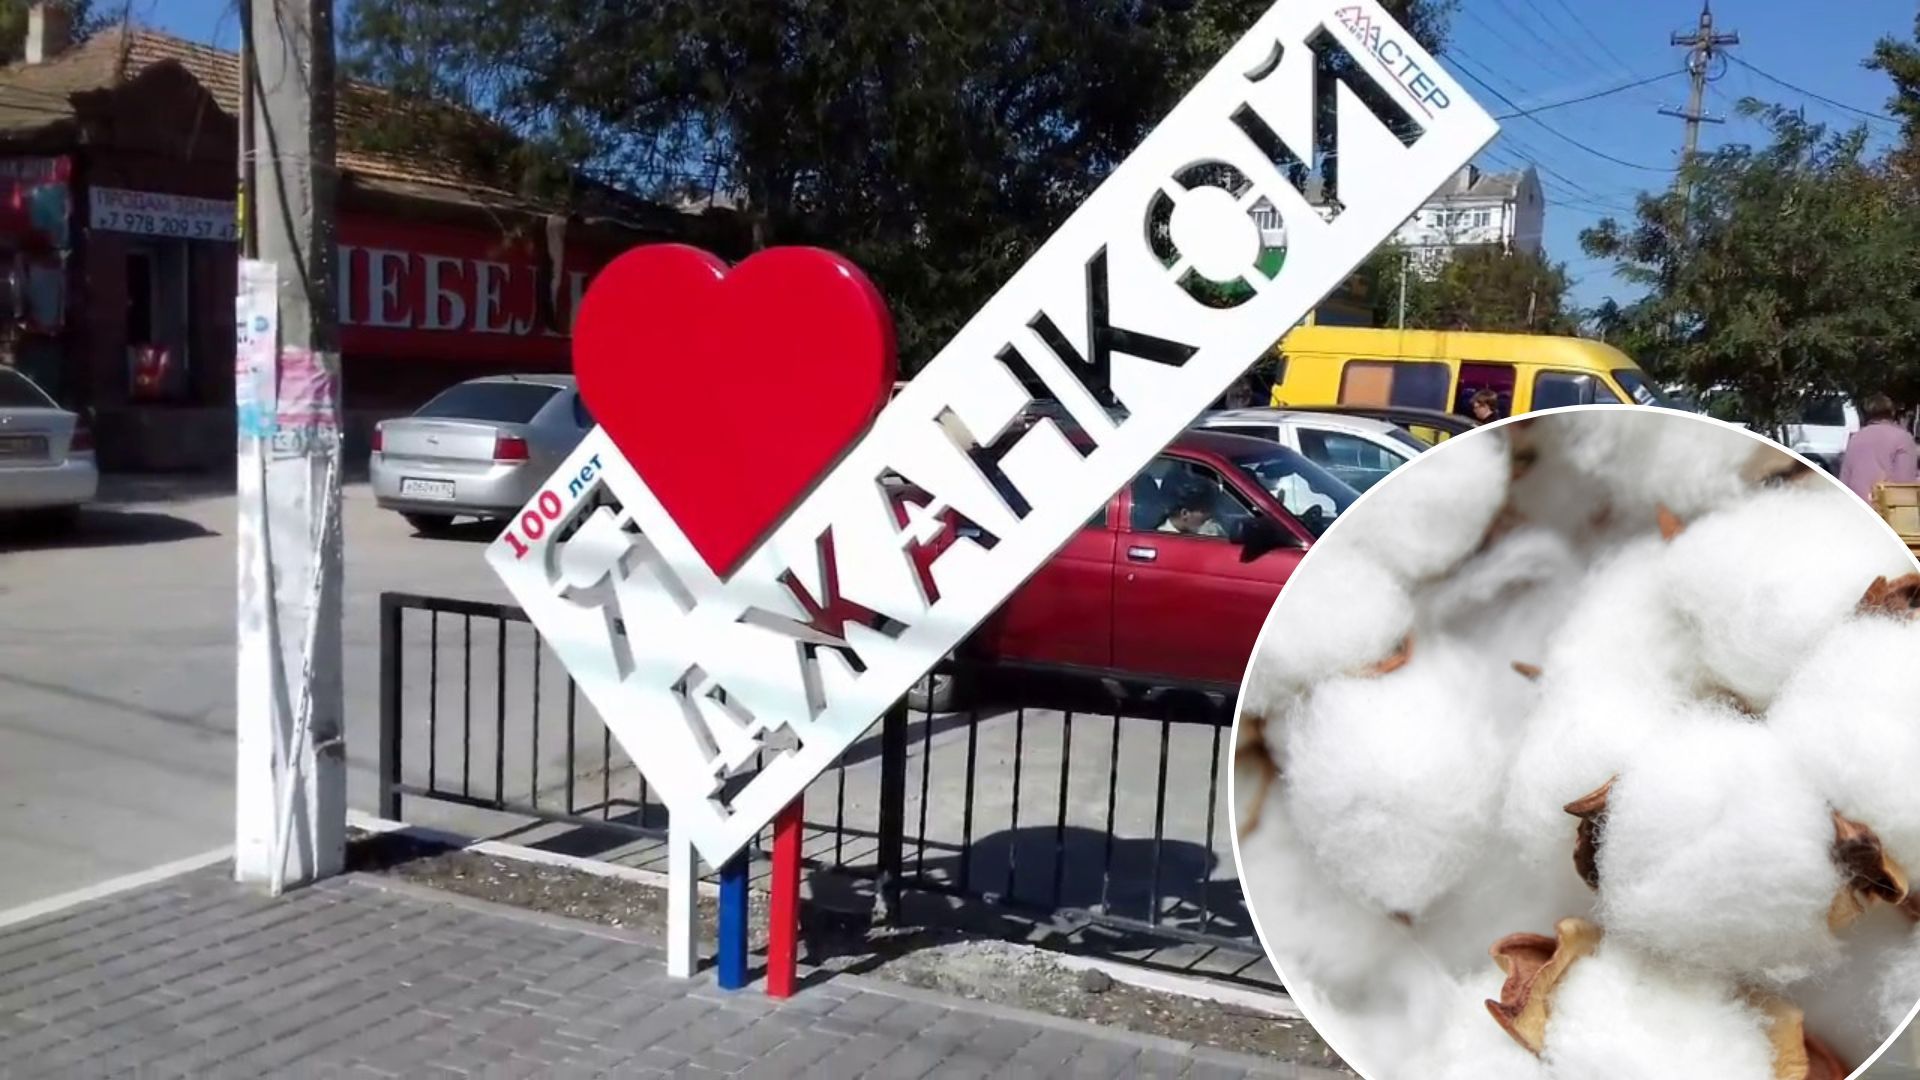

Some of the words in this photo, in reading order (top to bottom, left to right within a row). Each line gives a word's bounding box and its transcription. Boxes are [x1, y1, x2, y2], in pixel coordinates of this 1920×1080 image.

[1338, 6, 1451, 109] МАСТЕР
[97, 190, 171, 211] ПРОДАМ
[99, 211, 119, 227] +7
[124, 213, 155, 232] 978
[160, 217, 190, 235] 209
[193, 221, 213, 237] 57
[669, 20, 1428, 823] ДЖАНКОЙ
[503, 490, 562, 560] 100
[567, 453, 604, 499] лет
[544, 477, 698, 684] Я
